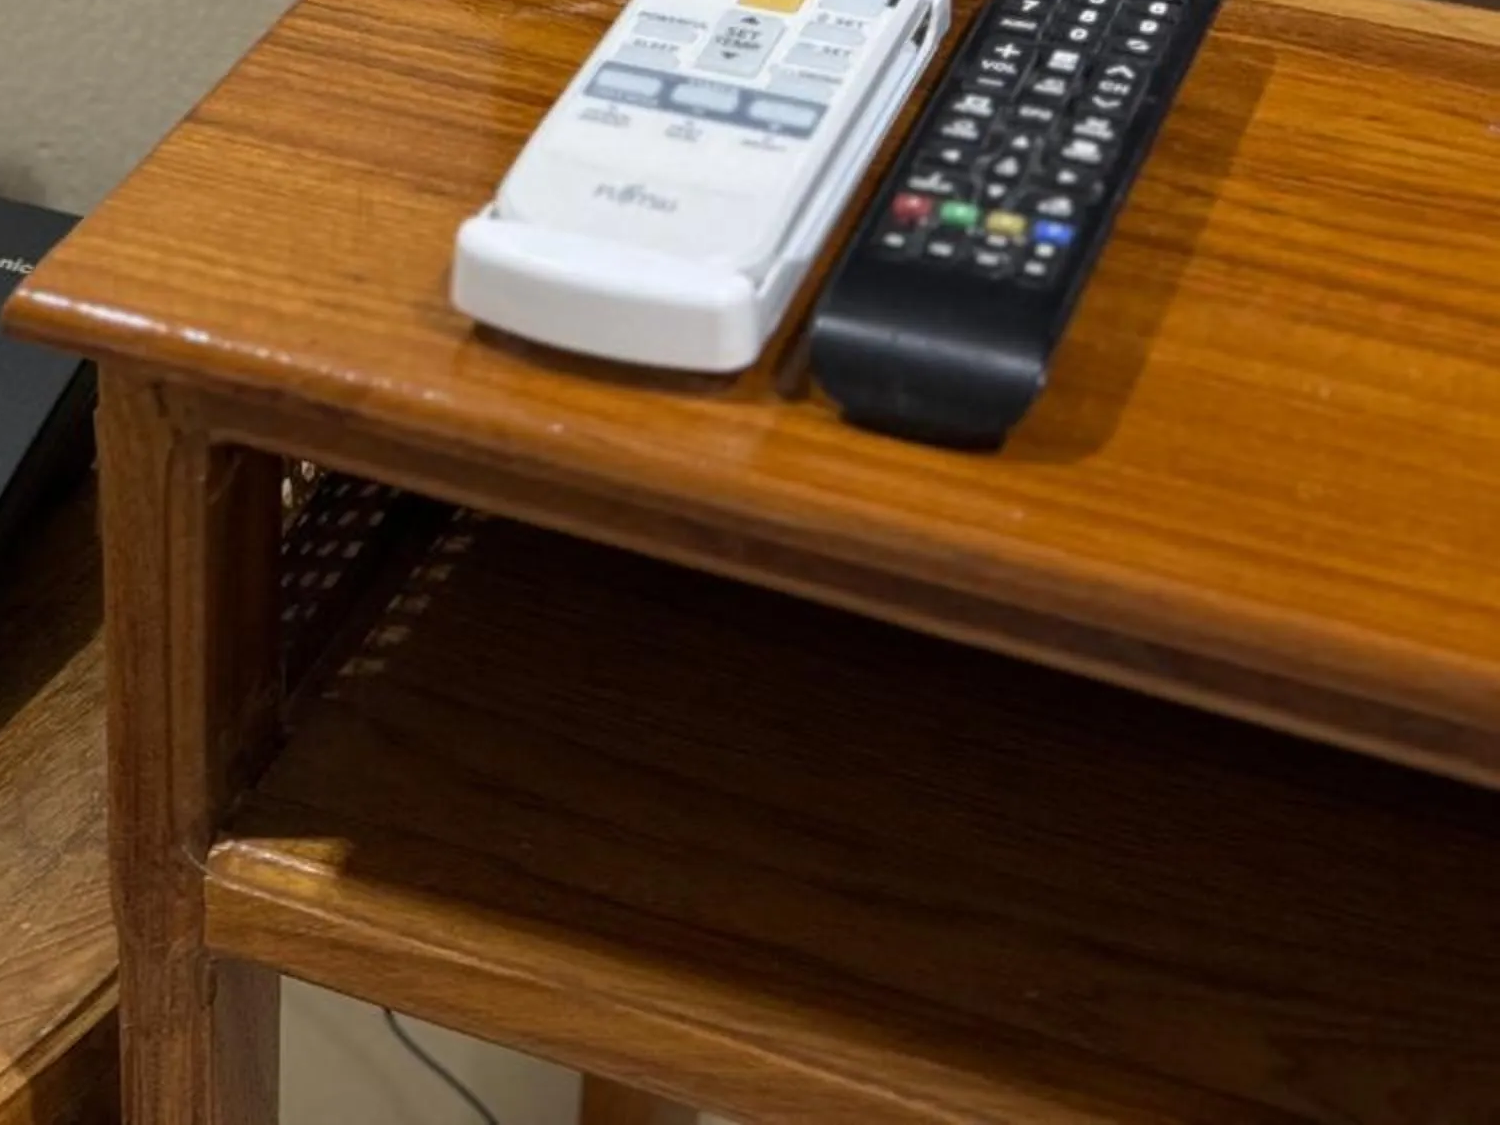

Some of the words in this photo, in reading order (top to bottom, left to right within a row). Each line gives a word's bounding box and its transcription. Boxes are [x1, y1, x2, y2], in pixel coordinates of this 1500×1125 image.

[1078, 9, 1099, 24] 8
[725, 26, 761, 41] SET
[1069, 26, 1089, 41] 0
[1139, 19, 1159, 34] 9
[980, 59, 1018, 74] VOL
[1098, 80, 1131, 96] CH
